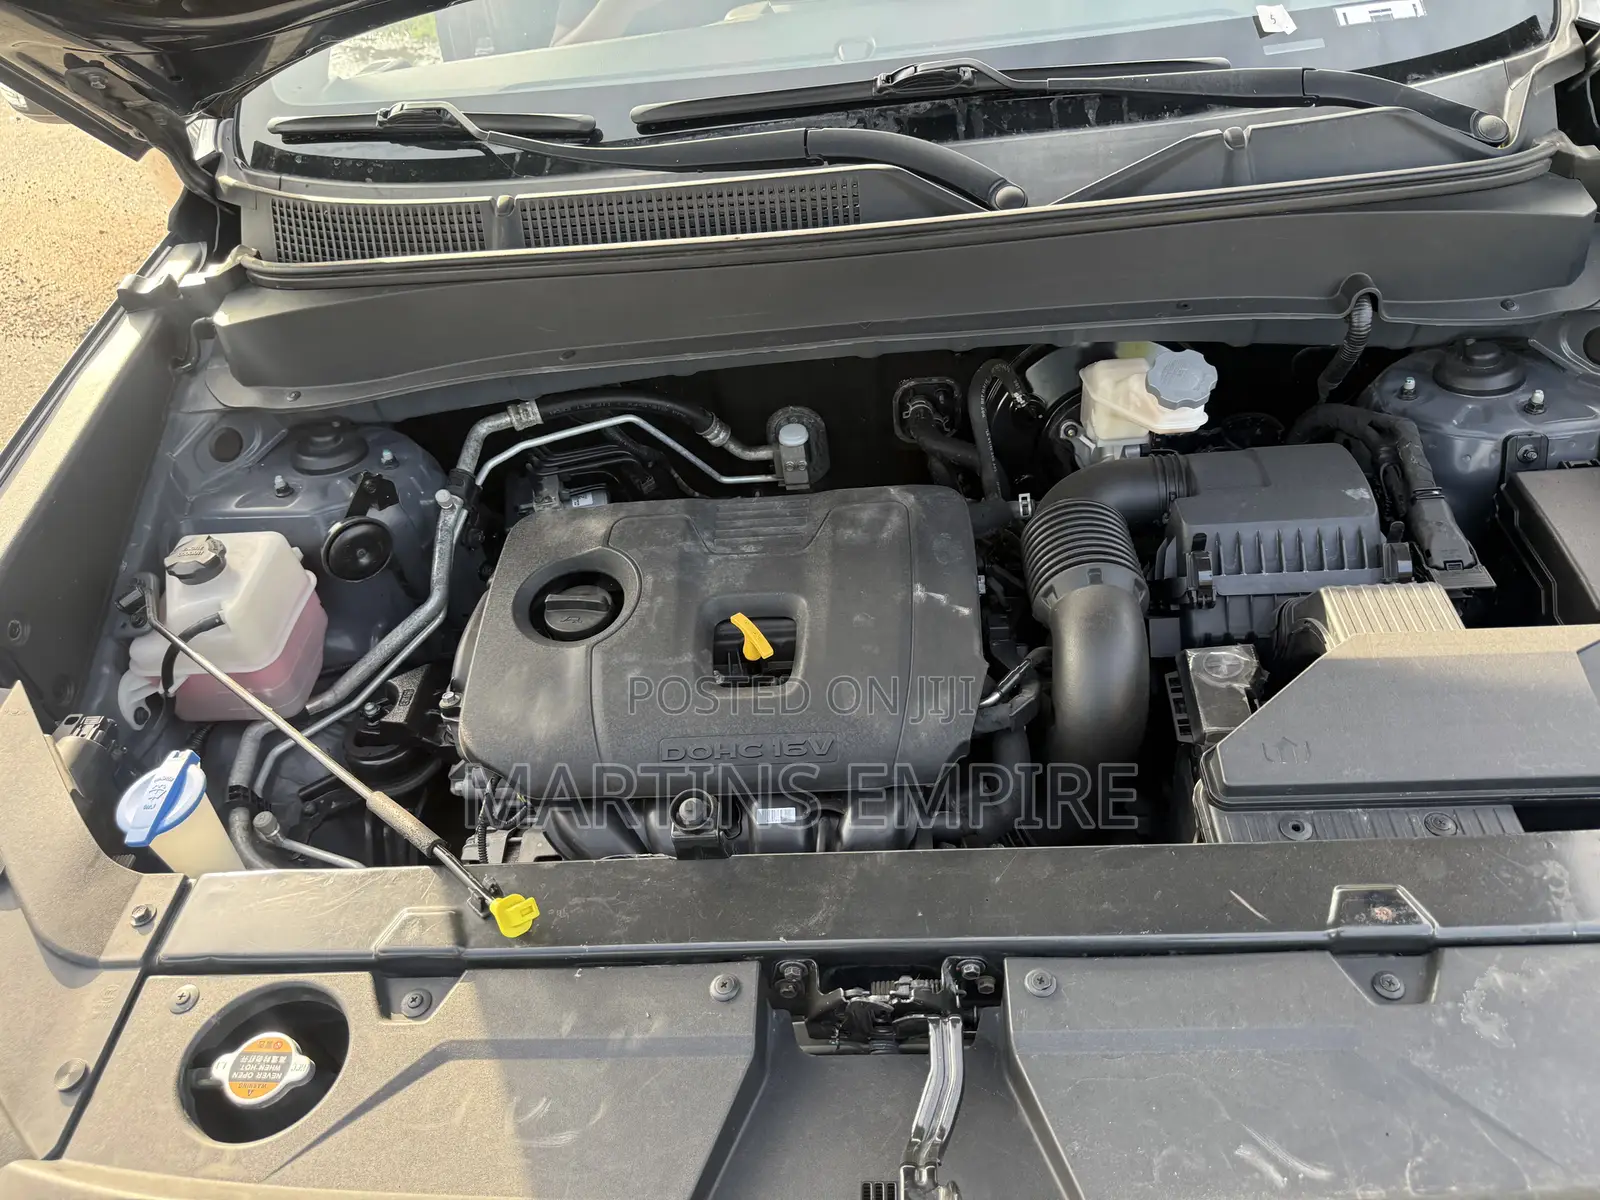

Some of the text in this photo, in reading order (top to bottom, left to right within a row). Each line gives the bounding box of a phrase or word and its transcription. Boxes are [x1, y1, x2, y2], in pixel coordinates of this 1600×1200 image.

[661, 736, 835, 762] DOHC 16V
[231, 1071, 283, 1079] NEVER OPEN
